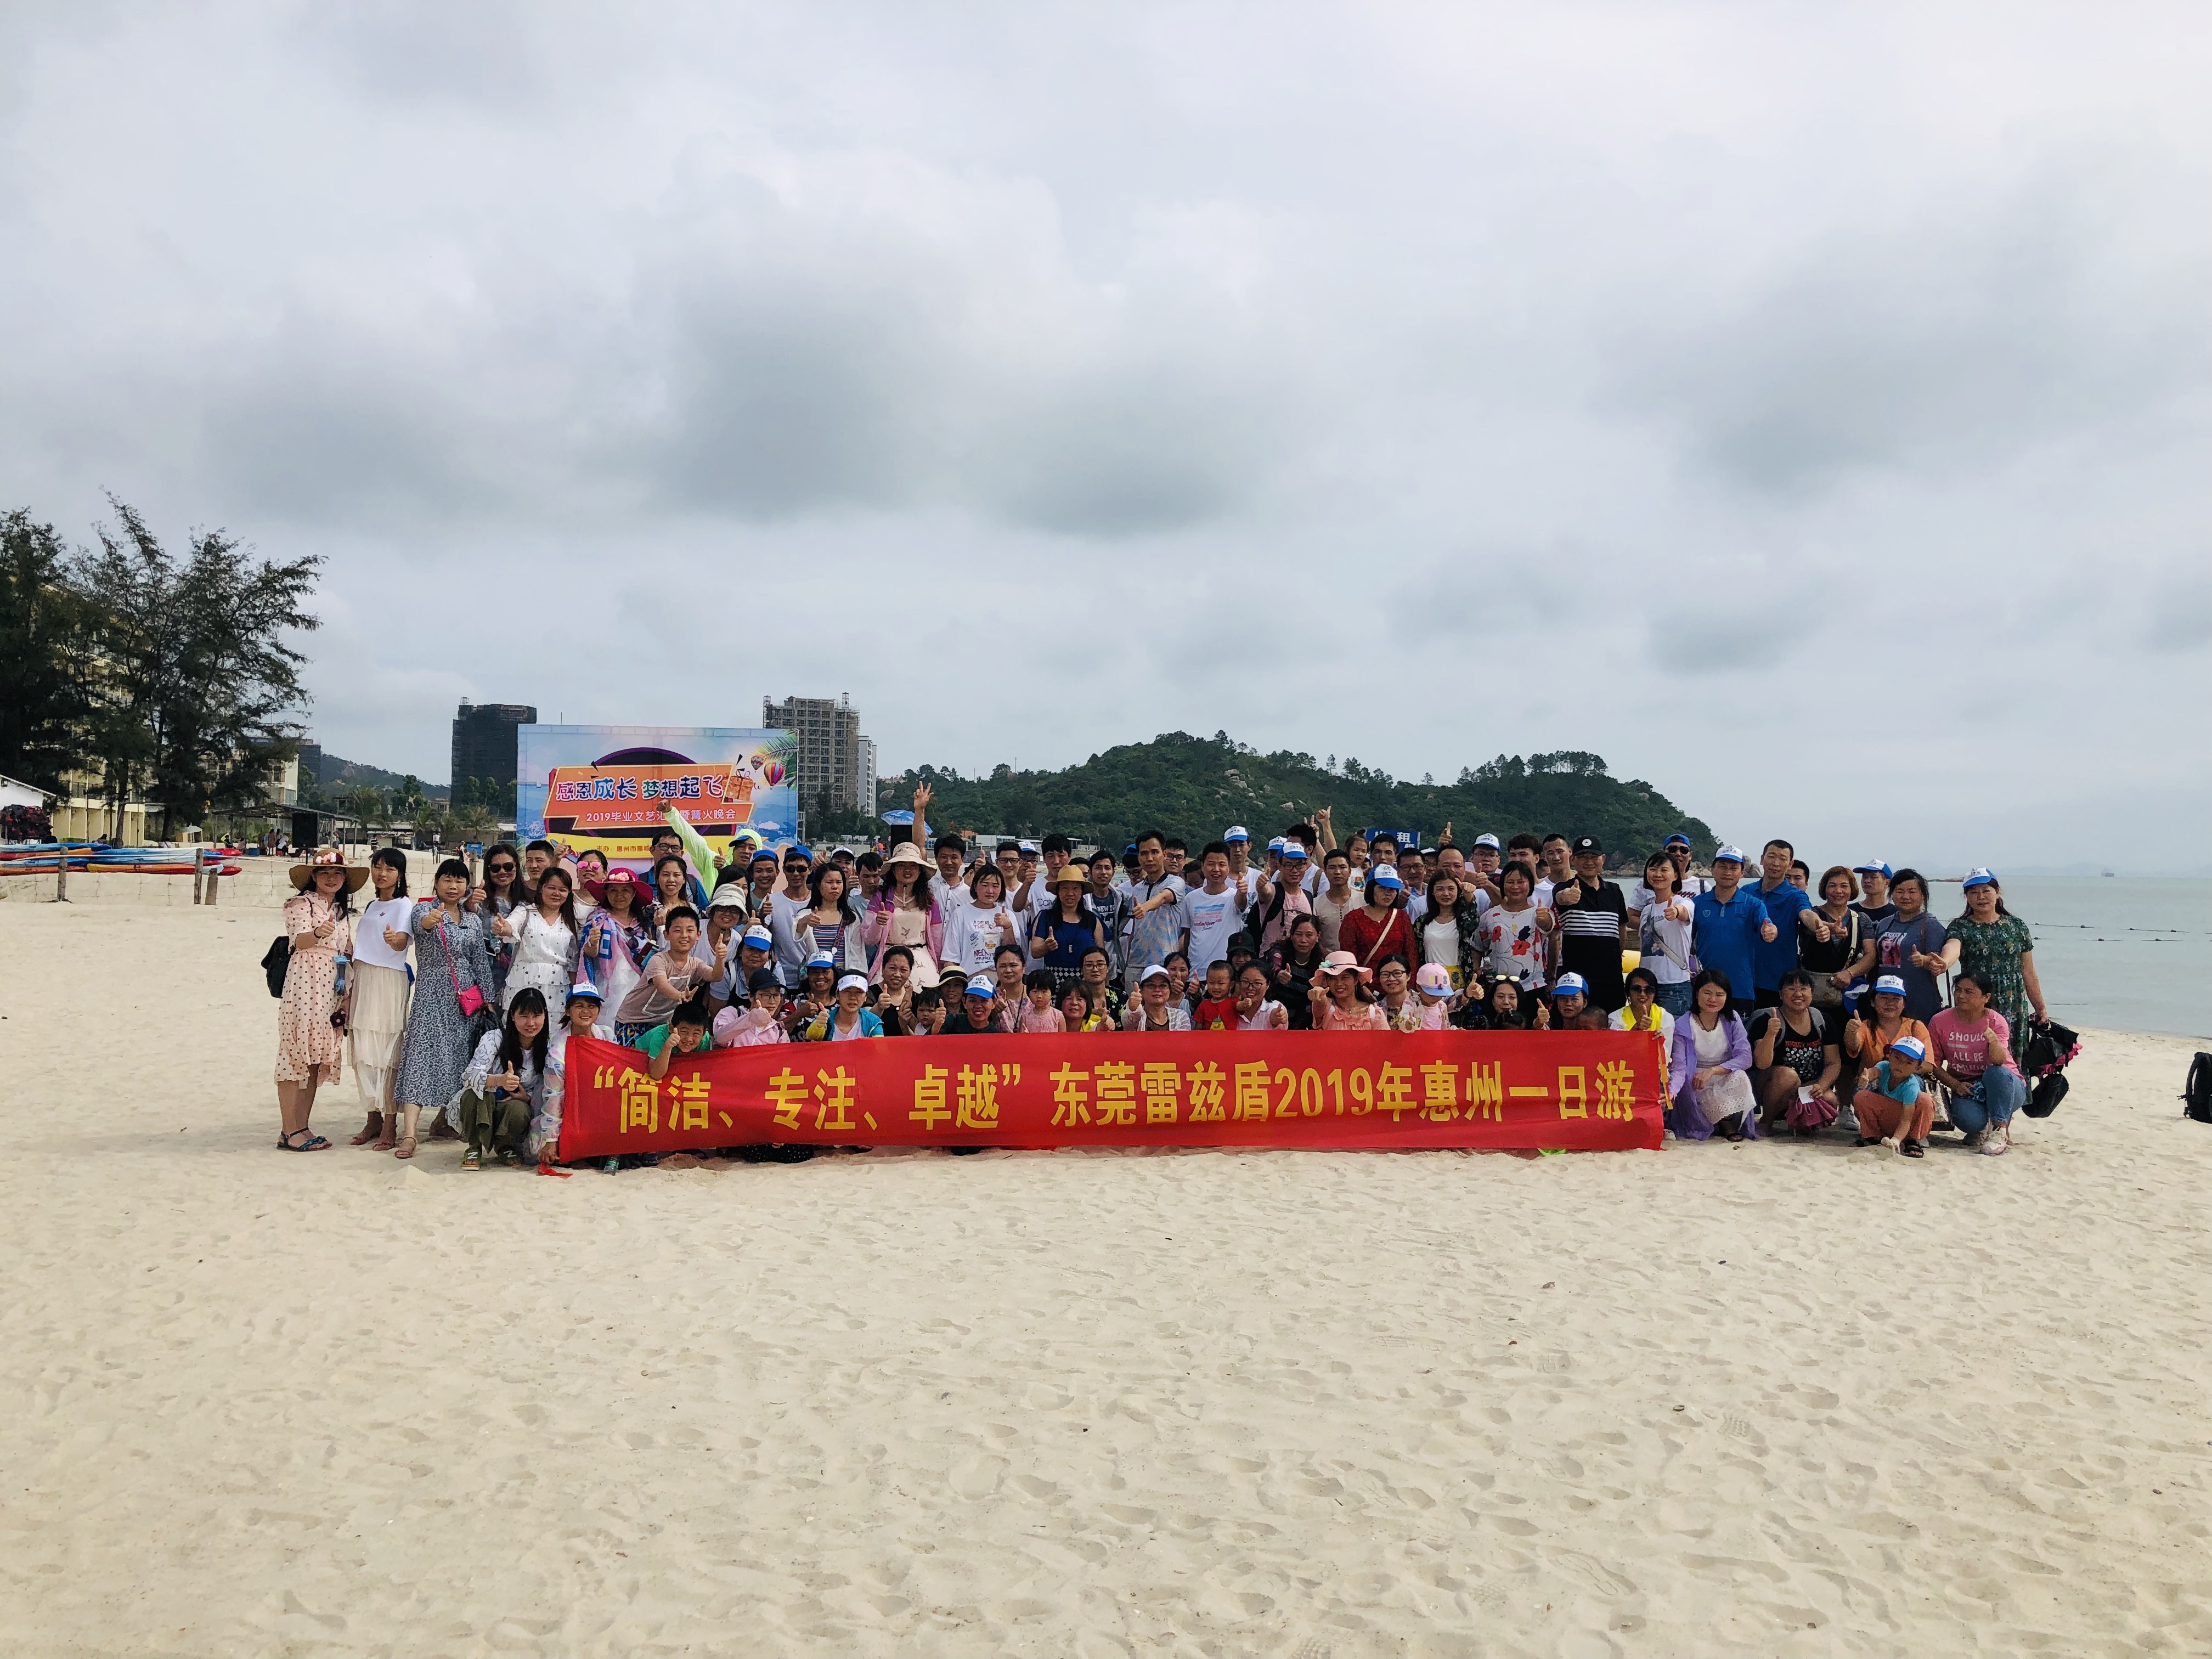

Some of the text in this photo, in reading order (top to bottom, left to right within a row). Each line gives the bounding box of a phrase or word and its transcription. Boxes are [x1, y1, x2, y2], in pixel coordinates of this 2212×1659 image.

[556, 775, 723, 802] 感恩成长 梦想起飞
[586, 808, 736, 822] 2019毕业文艺汇暨篝火晚会
[1036, 898, 1054, 906] Calv
[1954, 1051, 1984, 1062] ALL BE
